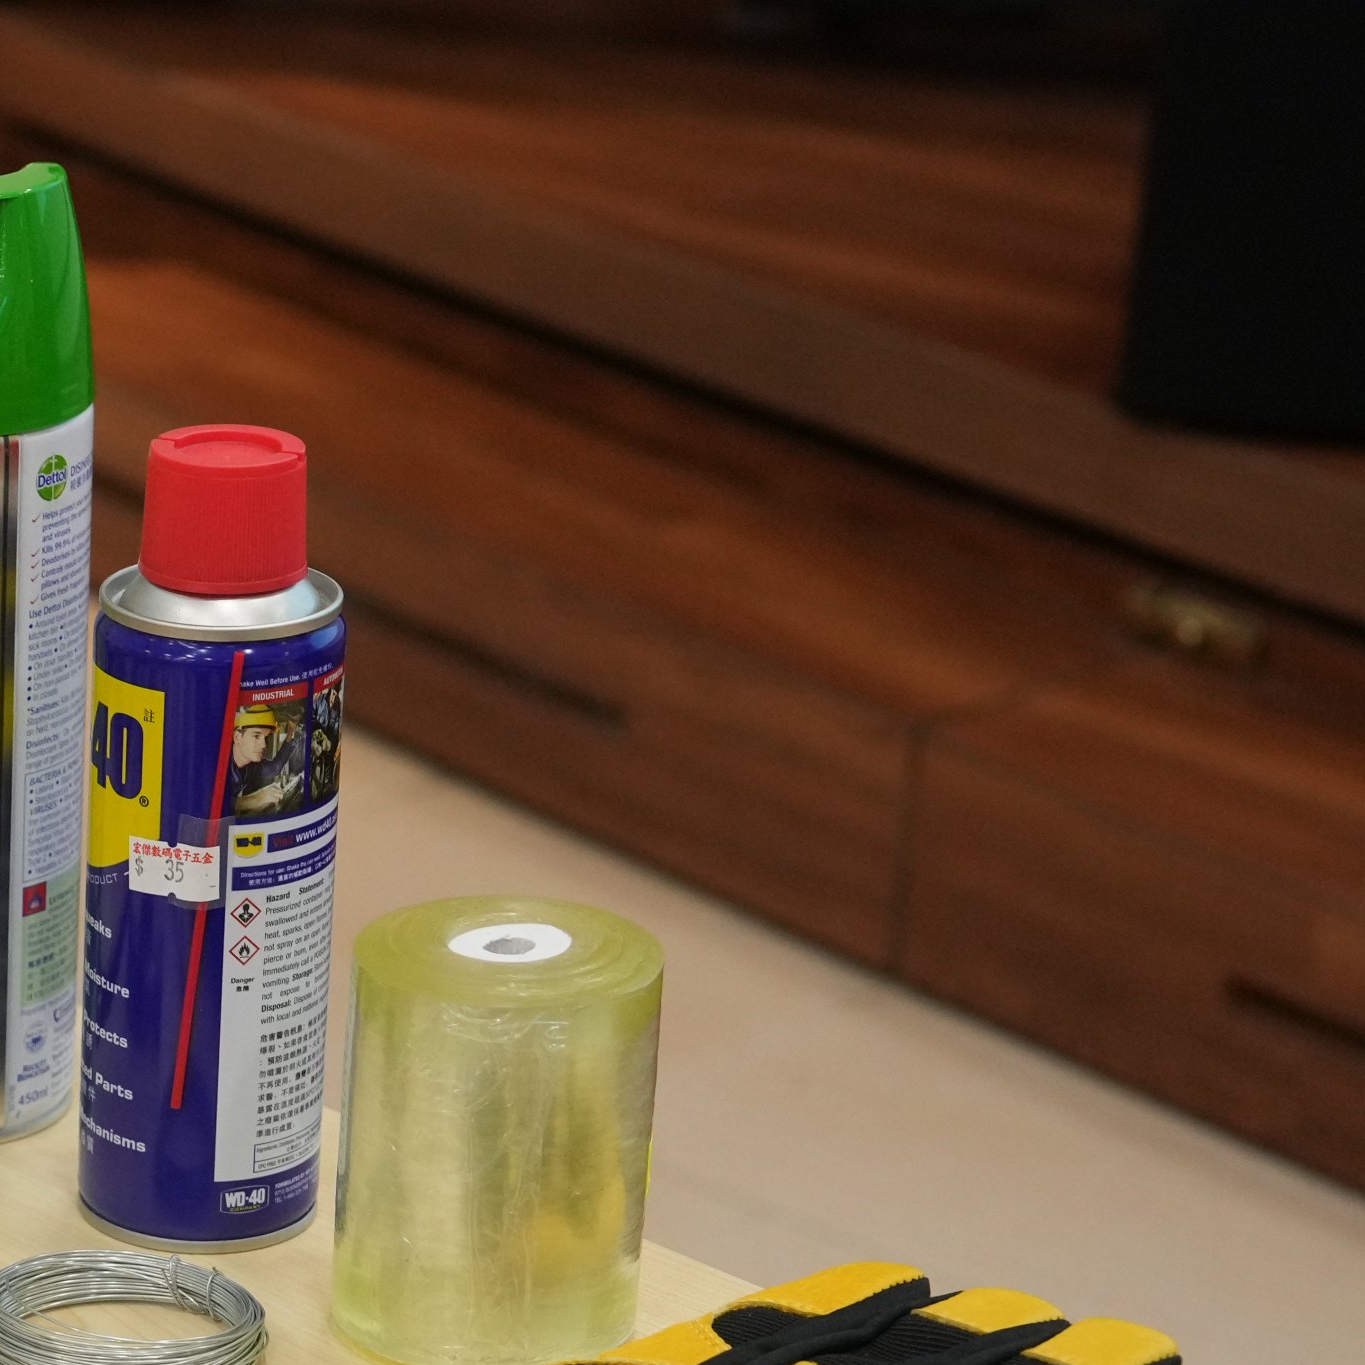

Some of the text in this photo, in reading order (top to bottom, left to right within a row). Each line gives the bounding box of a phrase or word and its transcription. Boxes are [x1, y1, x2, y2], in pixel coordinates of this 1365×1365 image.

[37, 468, 67, 488] Dettol
[256, 679, 269, 687] Well
[270, 677, 288, 685] Before
[253, 689, 294, 701] INDUSTRIAL
[163, 859, 184, 883] 35
[266, 891, 290, 902] Hazard
[265, 900, 301, 915] Pressurized
[264, 914, 298, 927] swallowed
[264, 944, 275, 952] not
[277, 939, 293, 950] spray
[264, 954, 283, 965] pierce
[262, 962, 300, 976] Immediately
[261, 992, 272, 1000] not
[280, 985, 300, 996] expose
[261, 1000, 292, 1012] Disposal:
[260, 1016, 275, 1025] with
[277, 1012, 290, 1022] local
[96, 1072, 133, 1100] Parts
